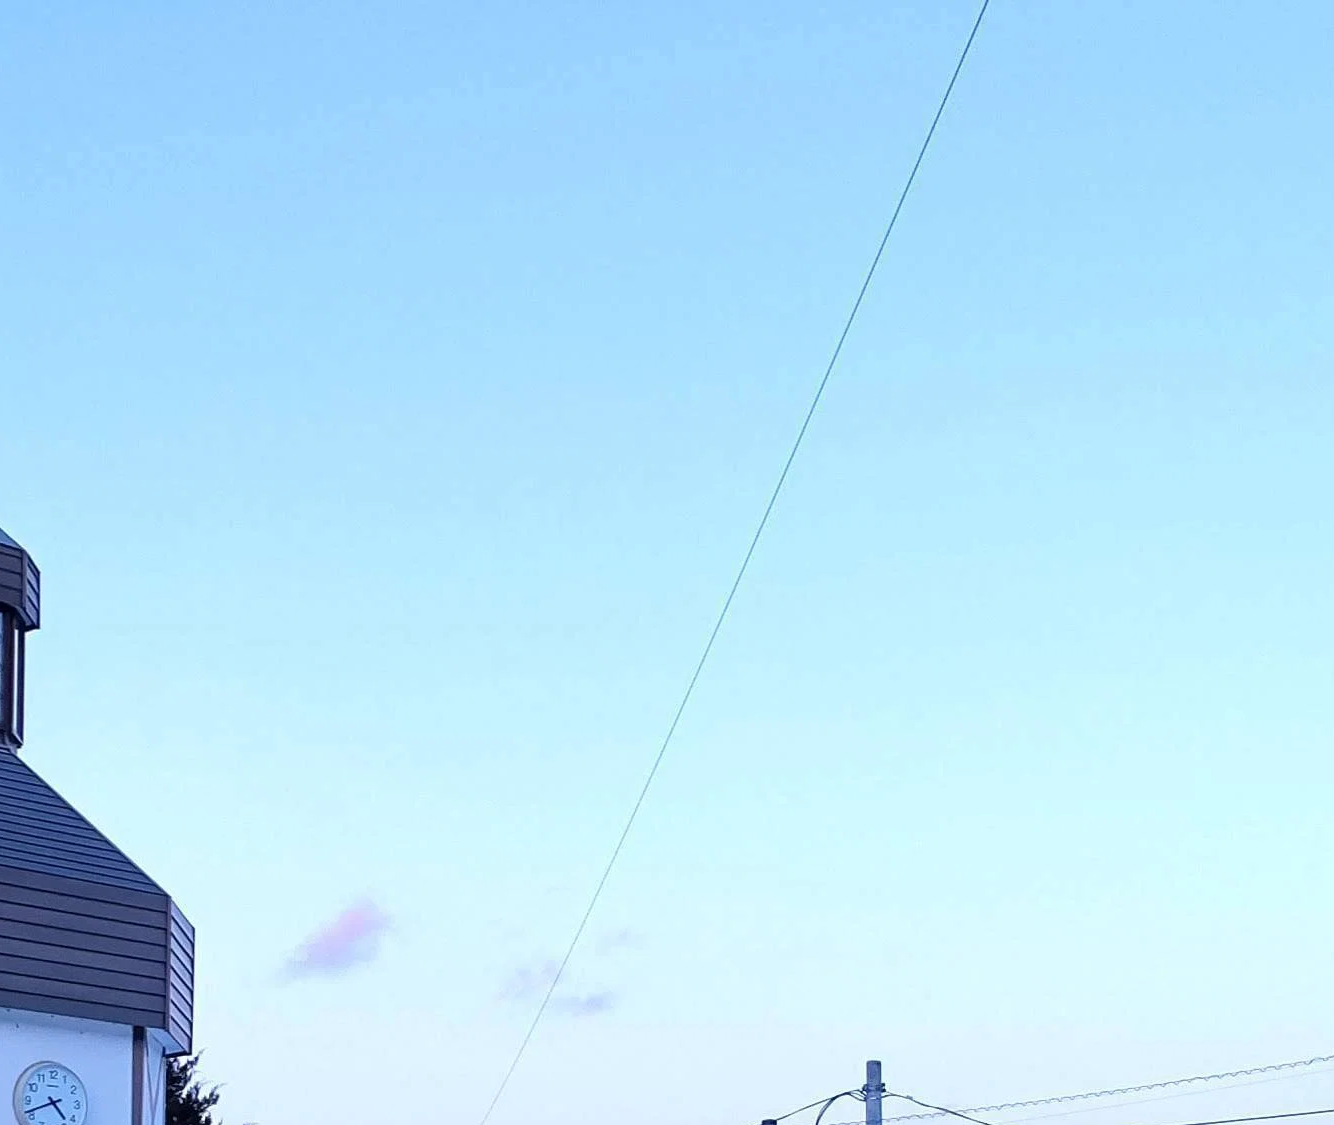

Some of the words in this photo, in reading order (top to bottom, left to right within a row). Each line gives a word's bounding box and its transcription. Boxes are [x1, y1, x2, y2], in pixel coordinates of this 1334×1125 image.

[37, 1074, 45, 1083] 11
[49, 1070, 59, 1080] 12
[62, 1075, 67, 1083] 1
[29, 1083, 38, 1092] 10
[70, 1085, 77, 1095] 2
[25, 1095, 31, 1105] 9
[74, 1099, 81, 1110] 3
[70, 1114, 76, 1123] 4
